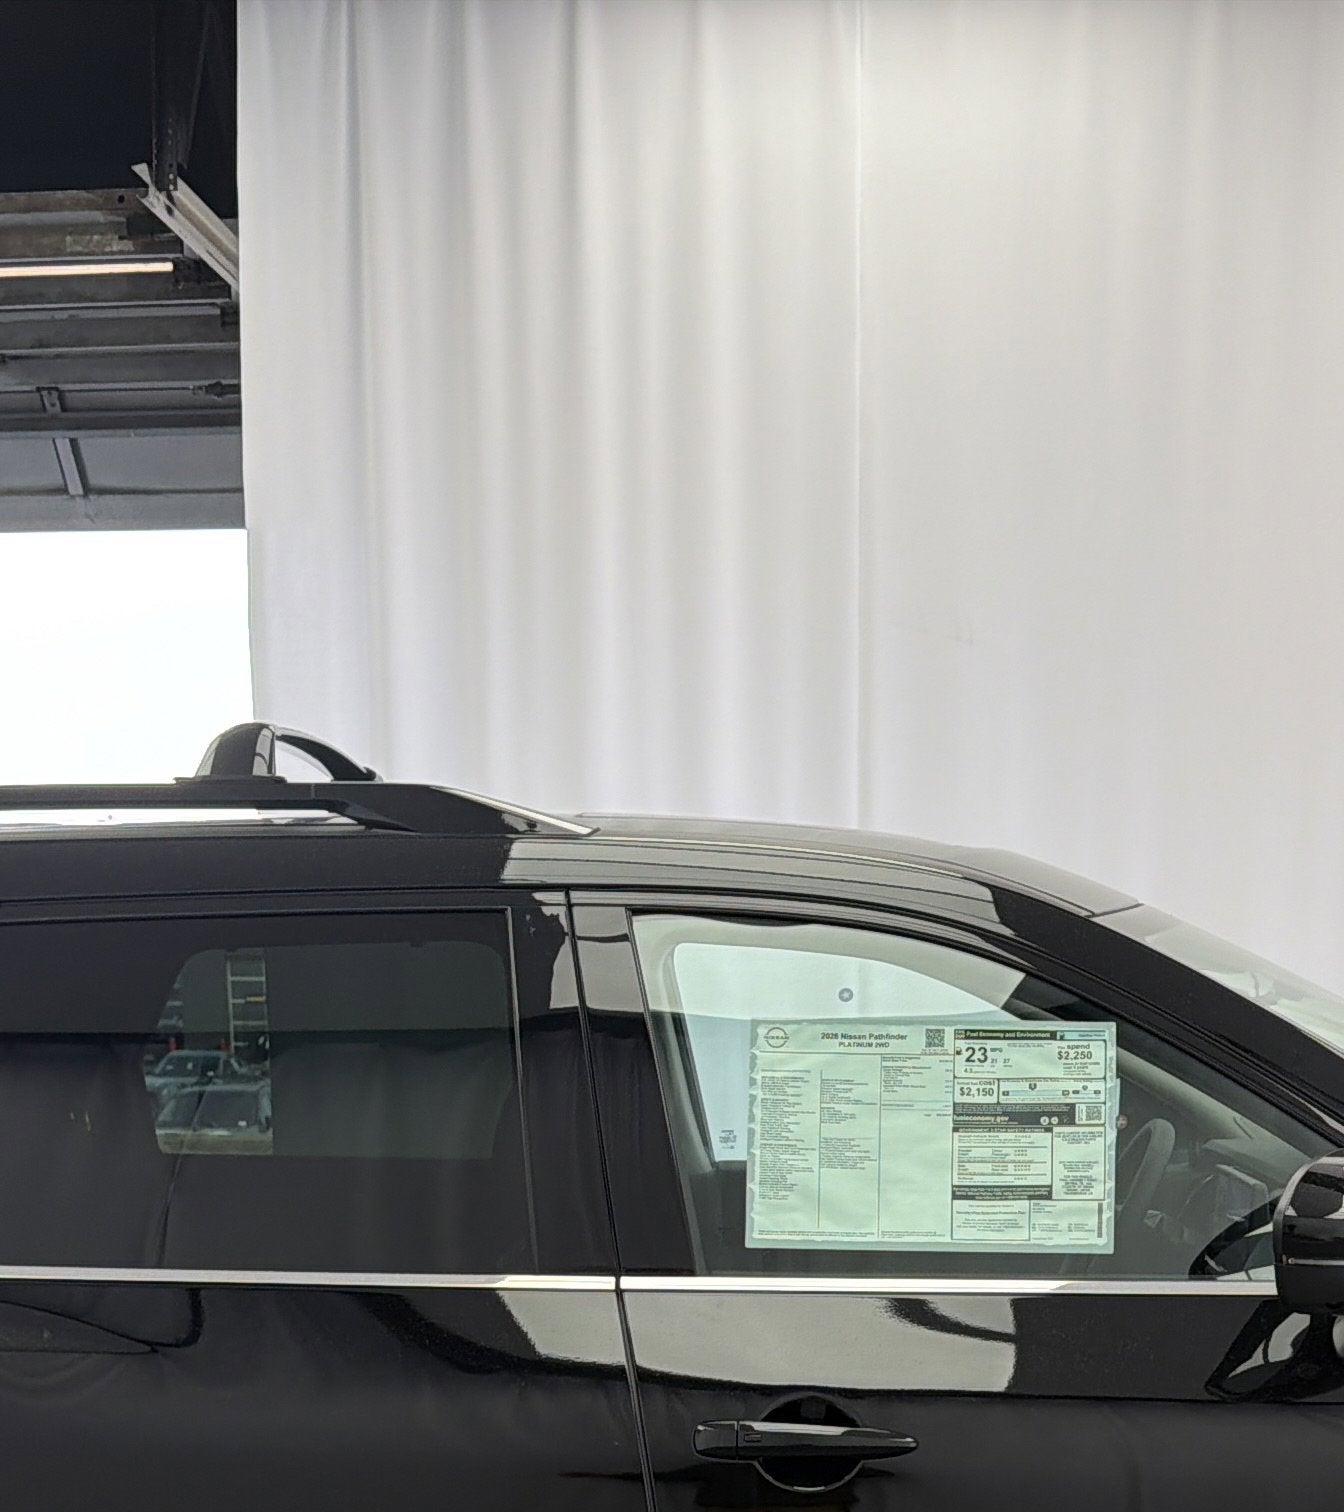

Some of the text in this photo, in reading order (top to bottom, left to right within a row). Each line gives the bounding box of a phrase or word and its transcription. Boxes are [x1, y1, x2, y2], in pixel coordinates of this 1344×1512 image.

[965, 1046, 988, 1063] 23
[1057, 1050, 1092, 1060] $2,250
[959, 1086, 994, 1098] $2,150
